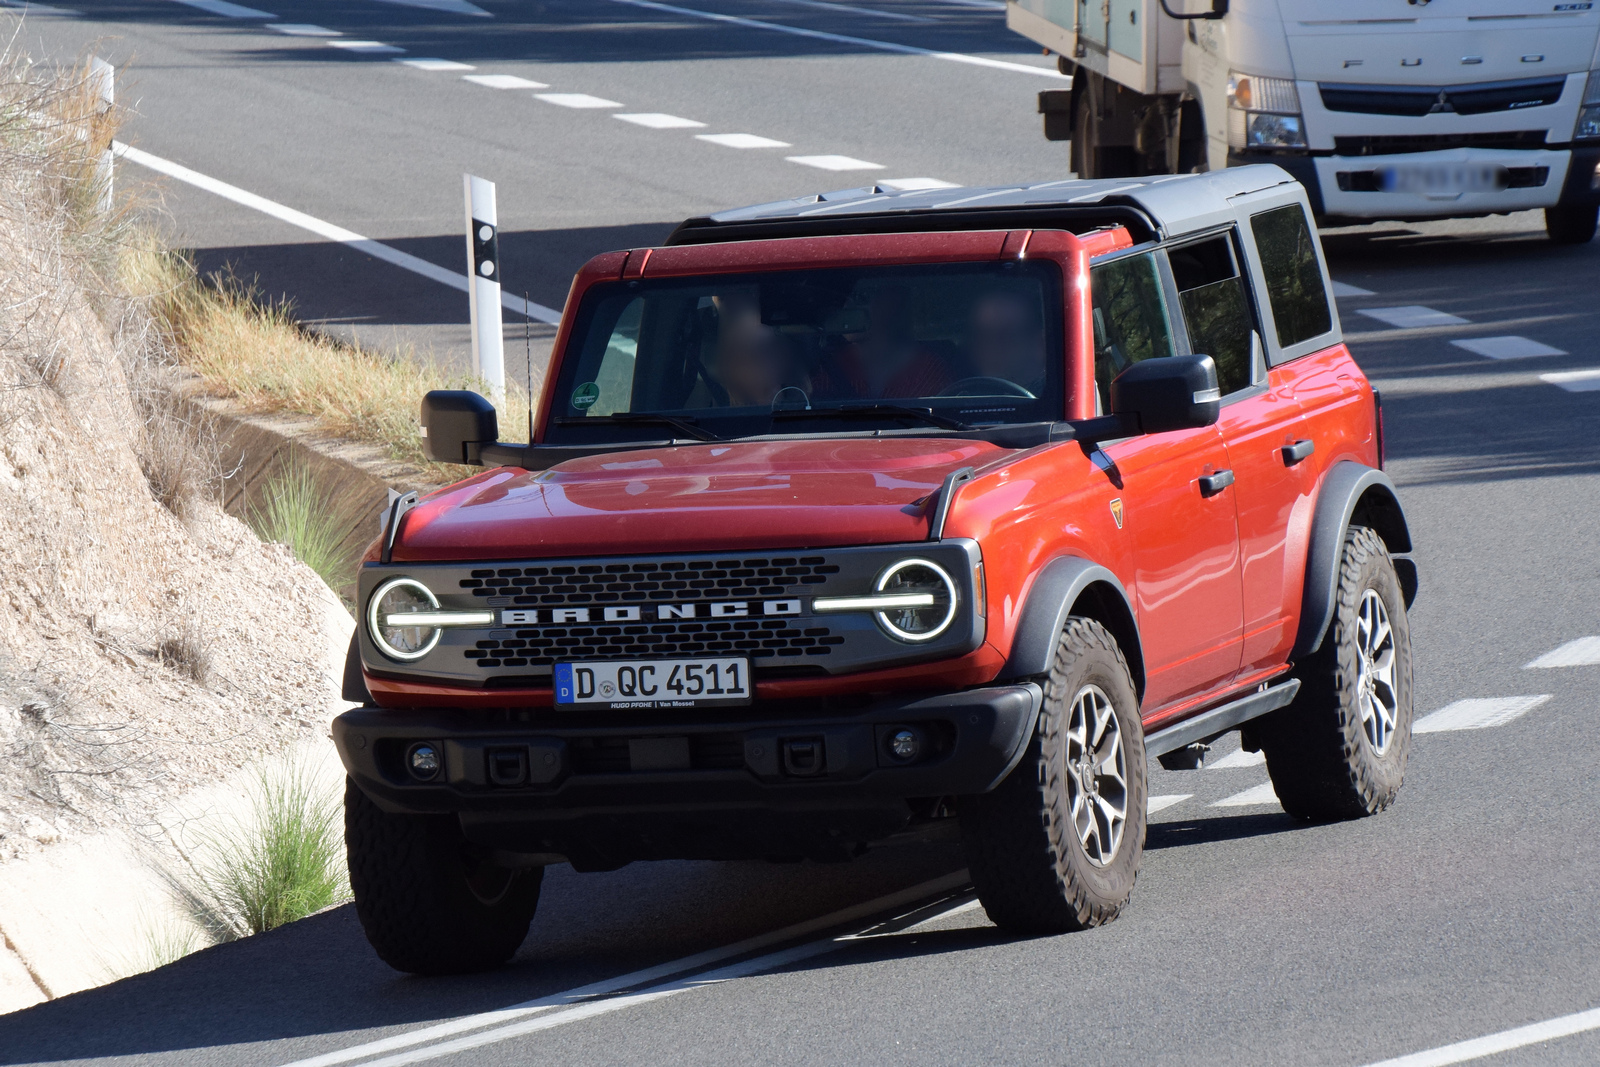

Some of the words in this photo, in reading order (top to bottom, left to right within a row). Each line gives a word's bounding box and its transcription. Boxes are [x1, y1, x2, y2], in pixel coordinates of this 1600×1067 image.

[1343, 54, 1544, 69] FUSO
[501, 600, 801, 625] BRONCO
[575, 668, 596, 699] D
[617, 665, 658, 697] QC
[666, 663, 745, 696] 4511
[561, 688, 569, 697] D
